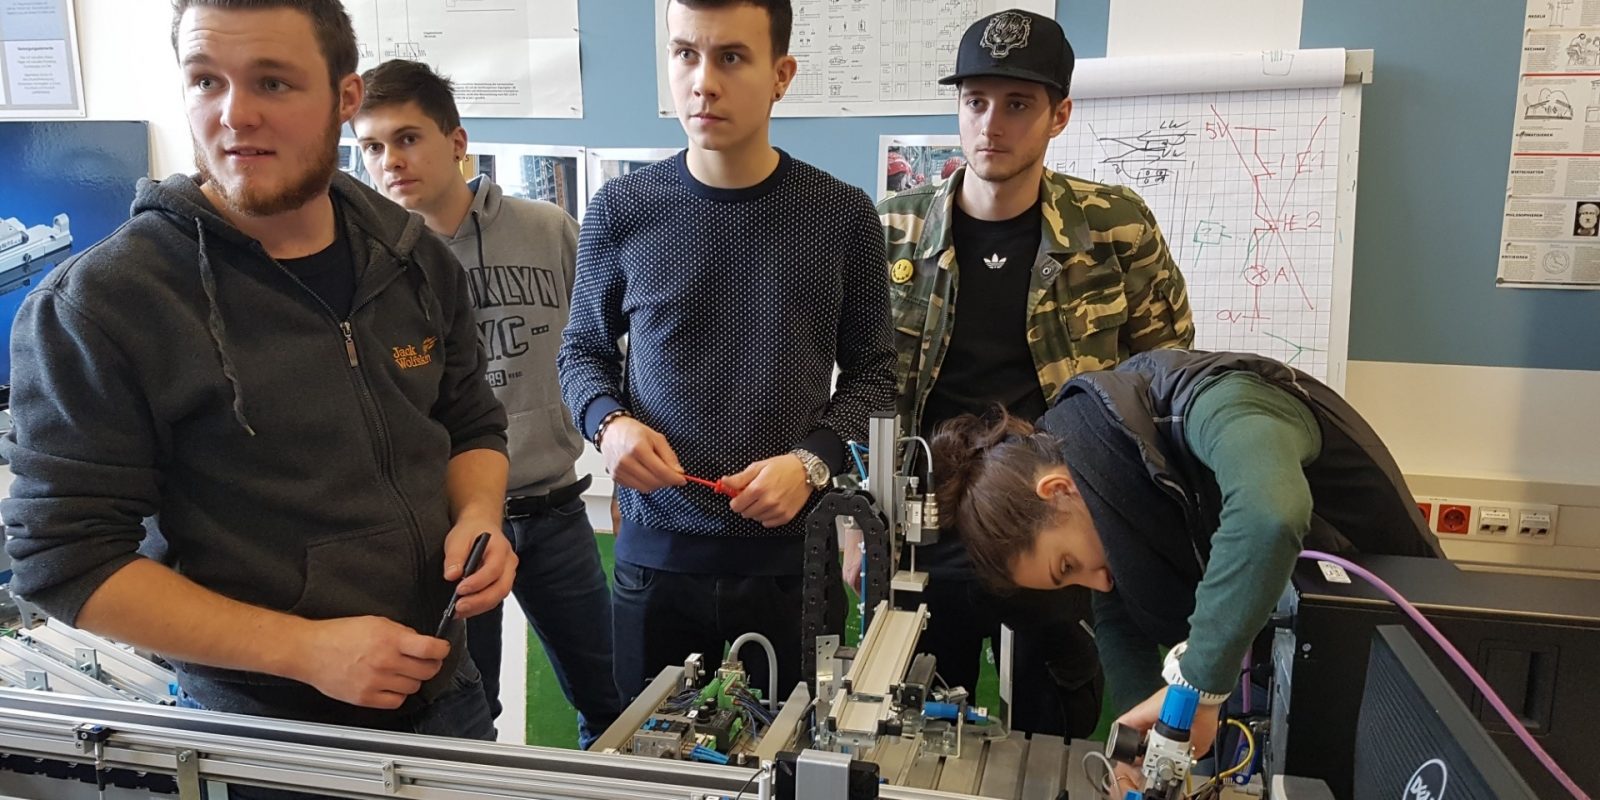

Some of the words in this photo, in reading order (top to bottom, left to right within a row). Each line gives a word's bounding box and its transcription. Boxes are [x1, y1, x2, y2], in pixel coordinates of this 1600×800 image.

[1206, 122, 1229, 139] 5V
[465, 265, 560, 309] KLYN
[392, 344, 417, 359] Jack
